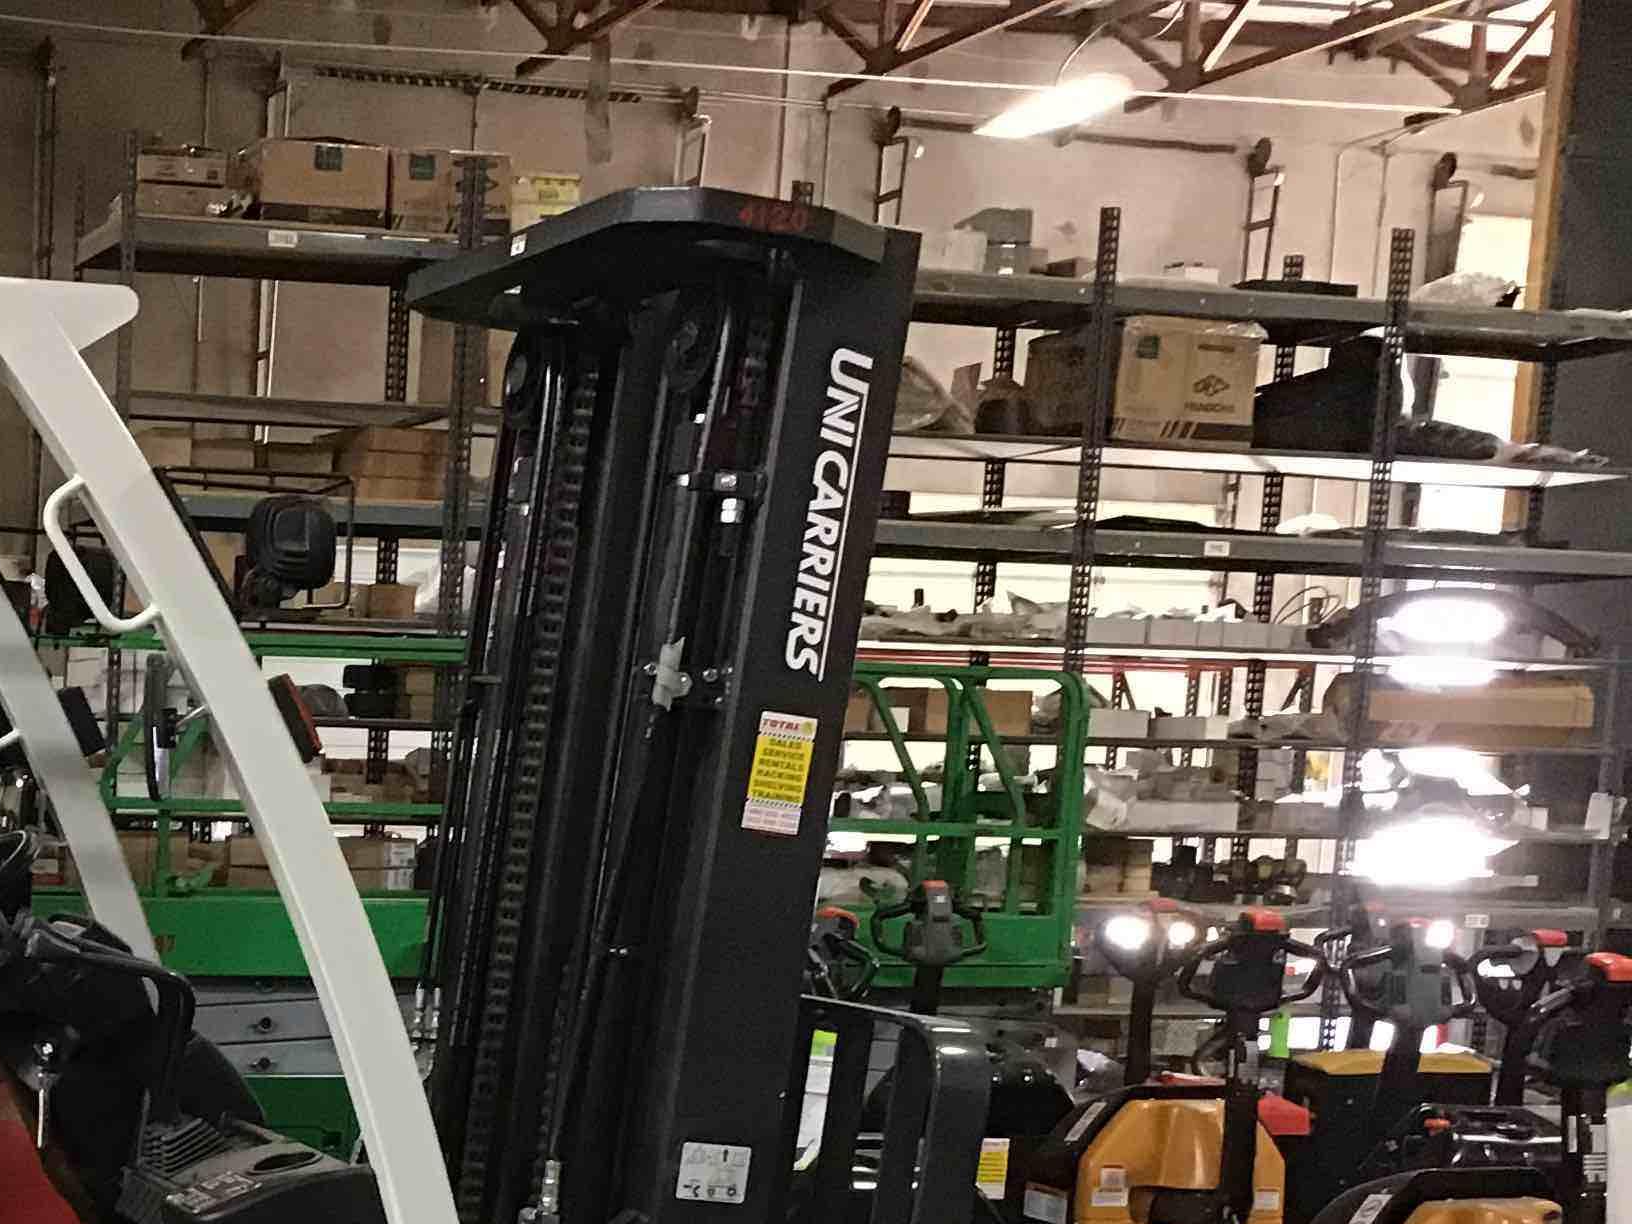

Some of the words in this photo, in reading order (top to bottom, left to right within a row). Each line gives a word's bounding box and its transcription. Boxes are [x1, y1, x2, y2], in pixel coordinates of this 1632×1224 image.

[785, 347, 873, 675] UNICARRIERS
[762, 748, 805, 761] SERVICE
[758, 758, 804, 771] RENTALS
